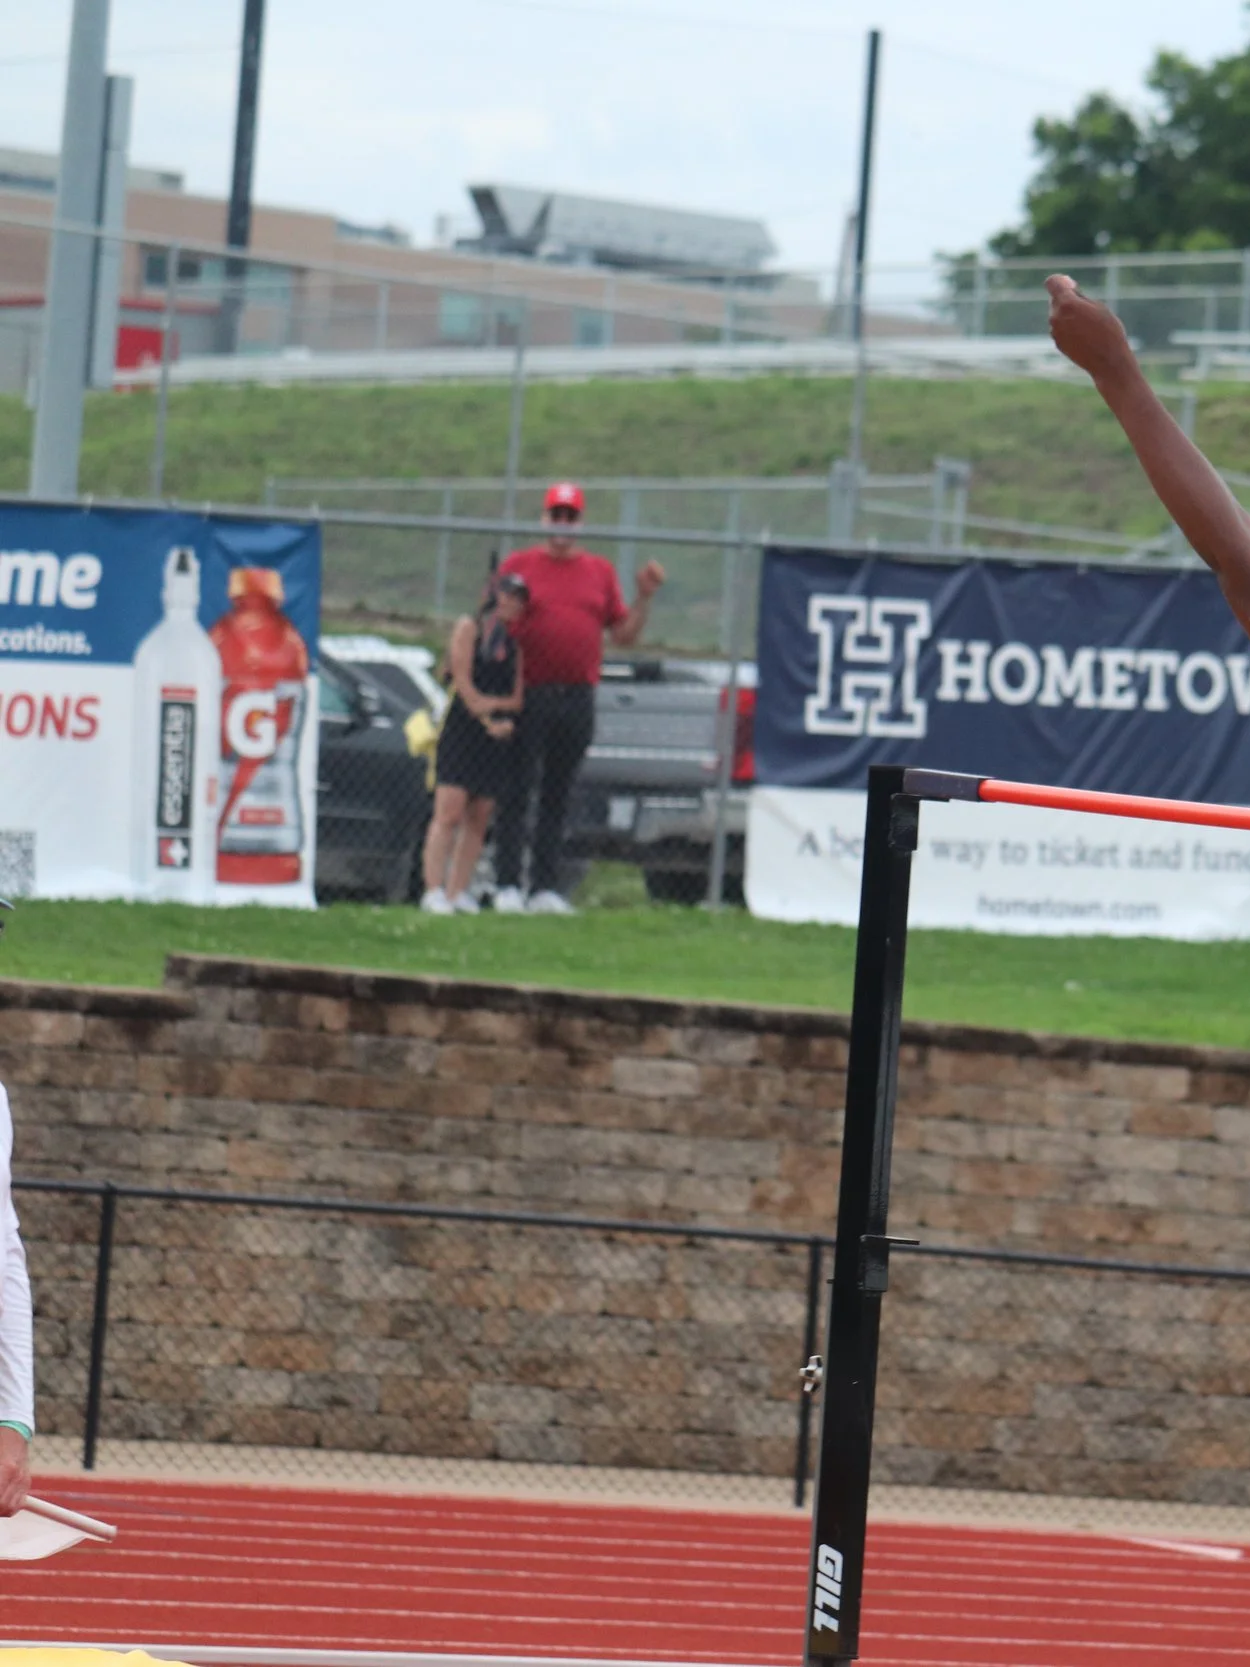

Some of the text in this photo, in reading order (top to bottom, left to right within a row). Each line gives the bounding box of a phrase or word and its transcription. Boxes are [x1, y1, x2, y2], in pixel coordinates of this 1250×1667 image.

[803, 594, 932, 739] H
[225, 690, 277, 759] G
[797, 831, 821, 857] A
[929, 840, 993, 872] way
[1000, 837, 1032, 866] to
[1038, 839, 1120, 869] ticket
[1128, 842, 1182, 873] and
[977, 894, 1162, 921] hometown.com
[813, 1543, 844, 1633] GILL
